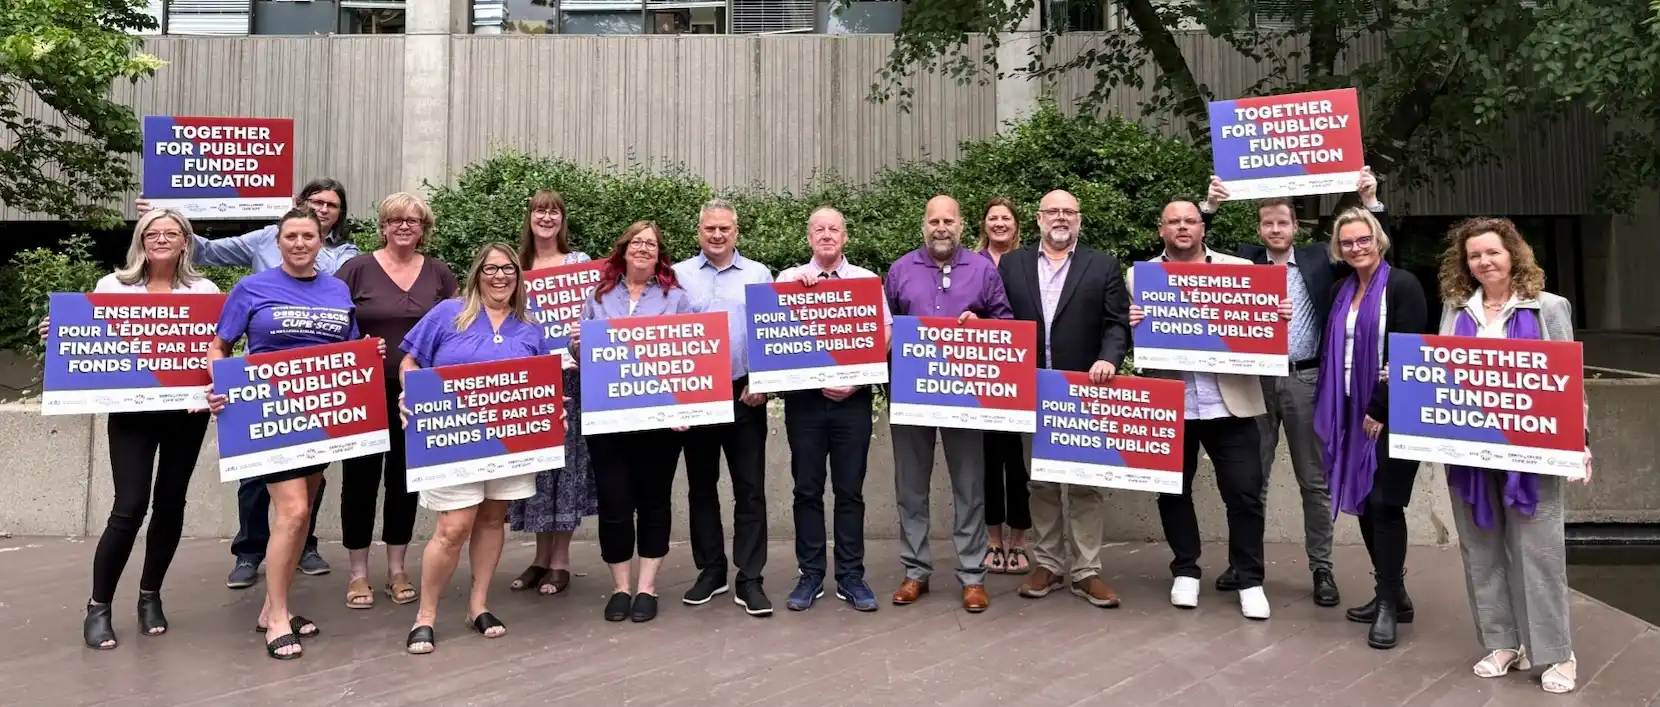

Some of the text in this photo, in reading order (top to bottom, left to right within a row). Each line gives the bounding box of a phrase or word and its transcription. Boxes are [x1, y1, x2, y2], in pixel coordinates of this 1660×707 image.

[1235, 100, 1332, 121] TOGETHER
[172, 126, 270, 139] TOGETHER
[1221, 115, 1349, 138] FOR PUBLICLY
[156, 142, 285, 155] FOR PUBLICLY
[1250, 134, 1324, 152] FUNDED
[184, 159, 258, 171] FUNDED
[1239, 148, 1343, 169] EDUCATION
[171, 174, 275, 187] EDUCATION
[1168, 275, 1250, 288] ENSEMBLE
[536, 286, 595, 307] PUBLI
[778, 291, 852, 306] ENSEMBLE
[1142, 288, 1279, 306] POUR L'ÉDUCATION
[93, 306, 190, 319] ENSEMBLE
[535, 304, 584, 323] UNDE
[754, 306, 876, 323] POUR L'ÉDUCATION
[1144, 305, 1278, 322] FINANCÉE PAR LES
[58, 326, 101, 337] POUR
[606, 323, 705, 343] TOGETHER
[756, 322, 877, 339] FINANCÉE PAR LES
[917, 327, 1012, 344] TOGETHER
[1152, 322, 1273, 338] FONDS PUBLICS
[59, 339, 152, 355] FINANCÉE
[158, 342, 185, 353] PAR
[592, 339, 720, 362] FOR PUBLICLY
[764, 337, 874, 355] FONDS PUBLICS
[903, 343, 1027, 362] FOR PUBLICLY
[68, 358, 207, 372] FONDS PUBLICS
[245, 352, 357, 381] TOGETHER
[1420, 346, 1548, 369] TOGETHER
[620, 360, 695, 378] FUNDED
[928, 362, 1000, 378] FUNDED
[1402, 365, 1570, 392] FOR PUBLICLY
[228, 367, 374, 403] FOR PUBLICLY
[443, 371, 528, 393] ENSEMBLE
[608, 375, 713, 397] EDUCATION
[916, 379, 1017, 397] EDUCATION
[415, 385, 555, 414] POUR L'ÉDUCATION
[1069, 384, 1150, 403] ENSEMBLE
[1436, 388, 1533, 410] FUNDED
[262, 391, 346, 418] FUNDED
[1042, 400, 1177, 422] POUR L'ÉDUCATION
[250, 406, 367, 440] EDUCATION
[417, 404, 555, 432] FINANCÉE PAR LES
[1043, 415, 1175, 438] FINANCÉE PAR LES
[1420, 407, 1557, 434] EDUCATION
[426, 420, 551, 448] FONDS PUBLICS
[1051, 432, 1170, 455] FONDS PUBLICS
